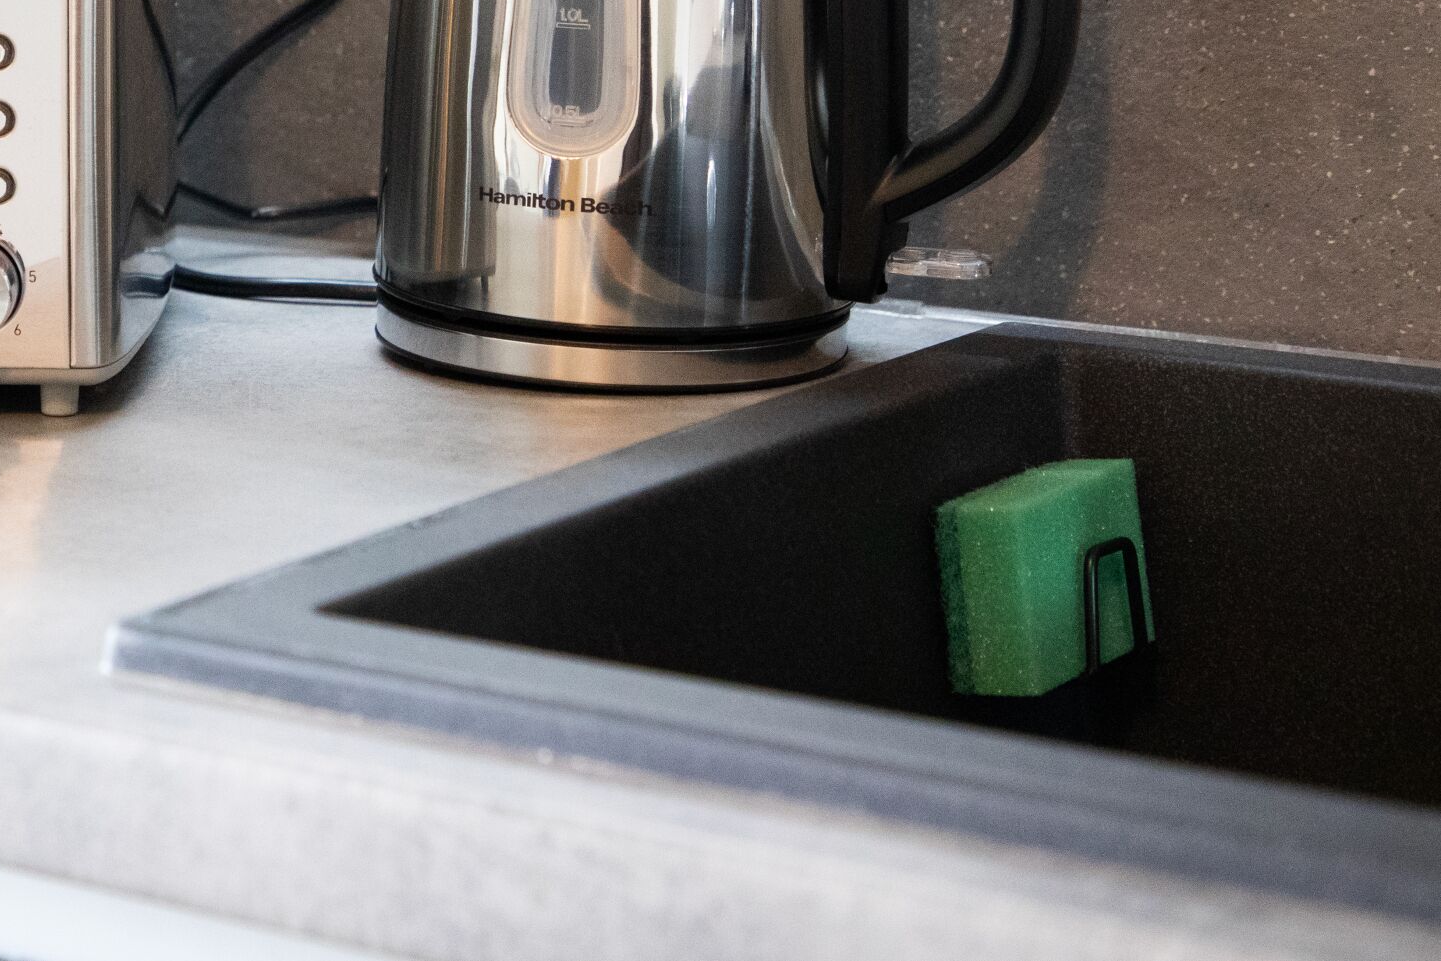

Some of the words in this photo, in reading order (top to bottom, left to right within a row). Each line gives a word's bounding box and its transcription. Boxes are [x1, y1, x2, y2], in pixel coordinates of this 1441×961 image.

[560, 7, 589, 23] 1.0L
[479, 186, 575, 212] Hamilton
[29, 270, 37, 283] 5
[13, 324, 22, 336] 6
